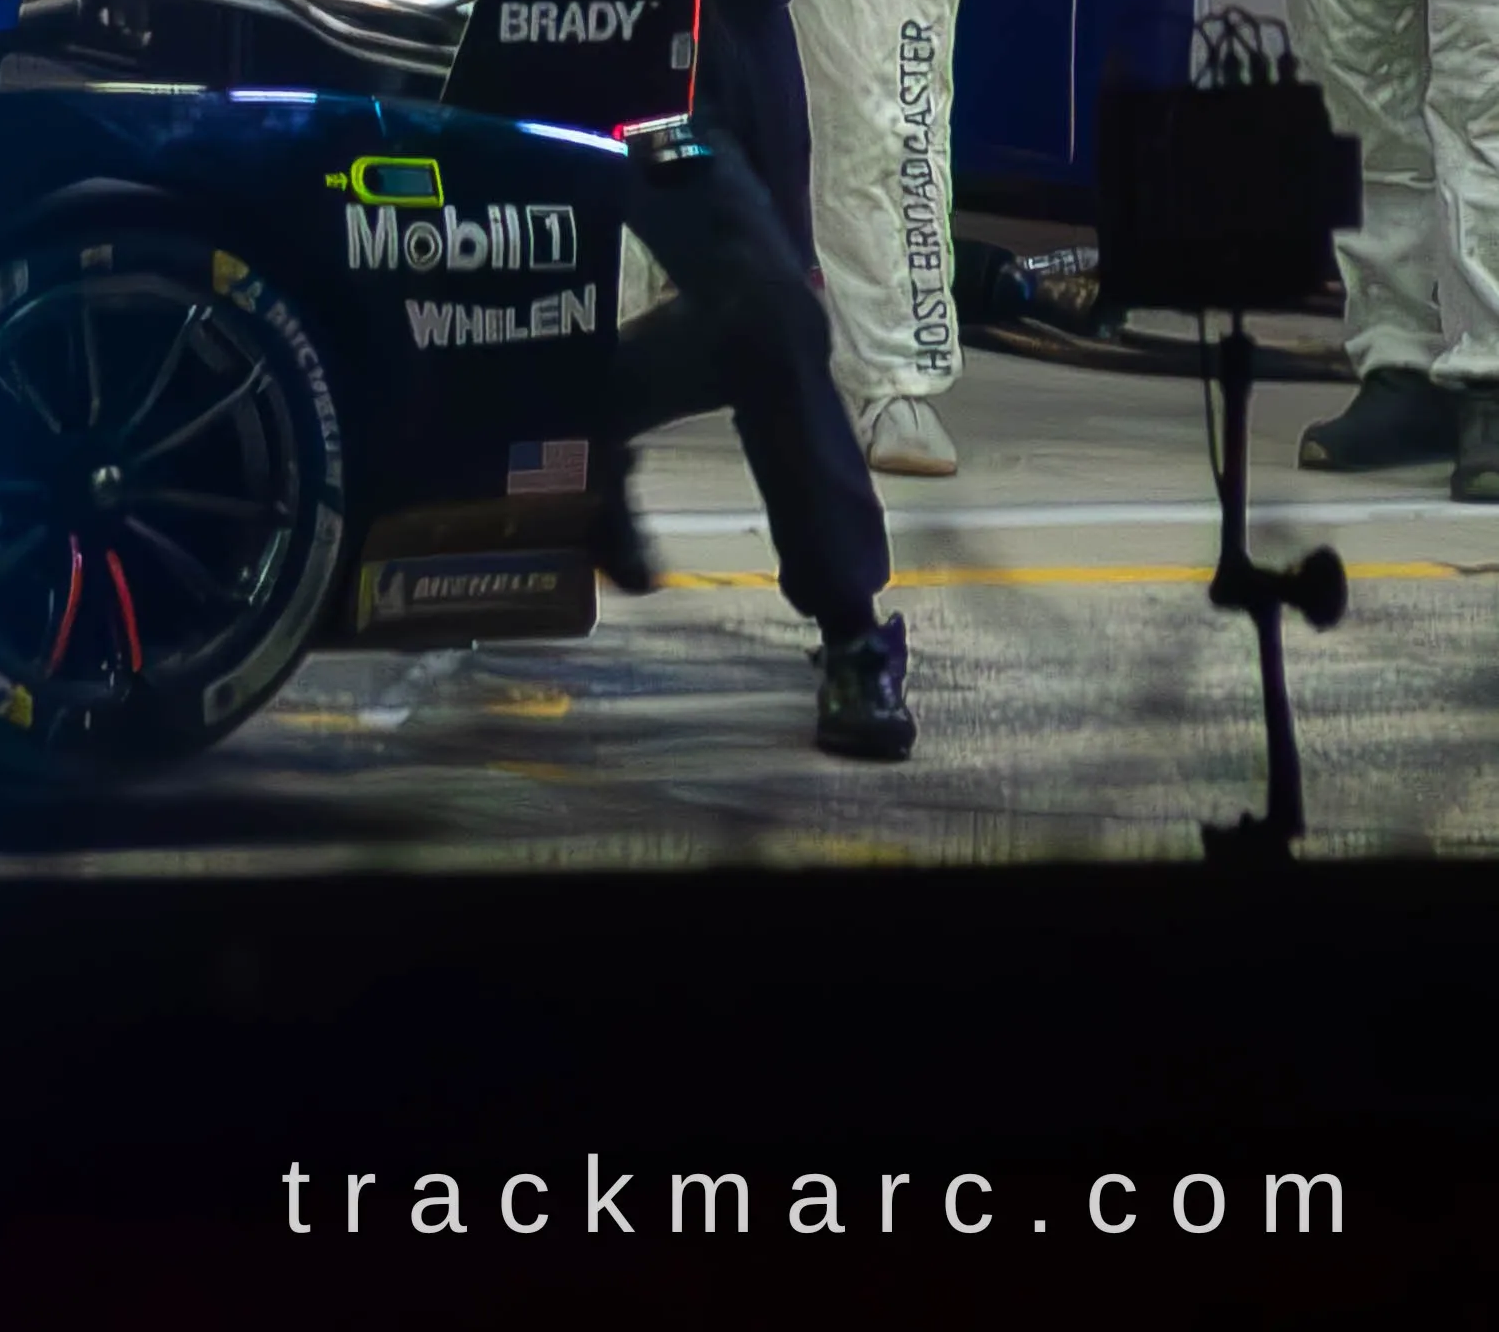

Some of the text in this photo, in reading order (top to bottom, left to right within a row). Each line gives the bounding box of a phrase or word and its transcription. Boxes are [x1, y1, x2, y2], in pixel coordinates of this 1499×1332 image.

[499, 0, 645, 46] BRADY
[899, 17, 952, 377] HOST BROADCASTER
[345, 204, 521, 273] Mobil
[405, 282, 597, 349] WHELEN
